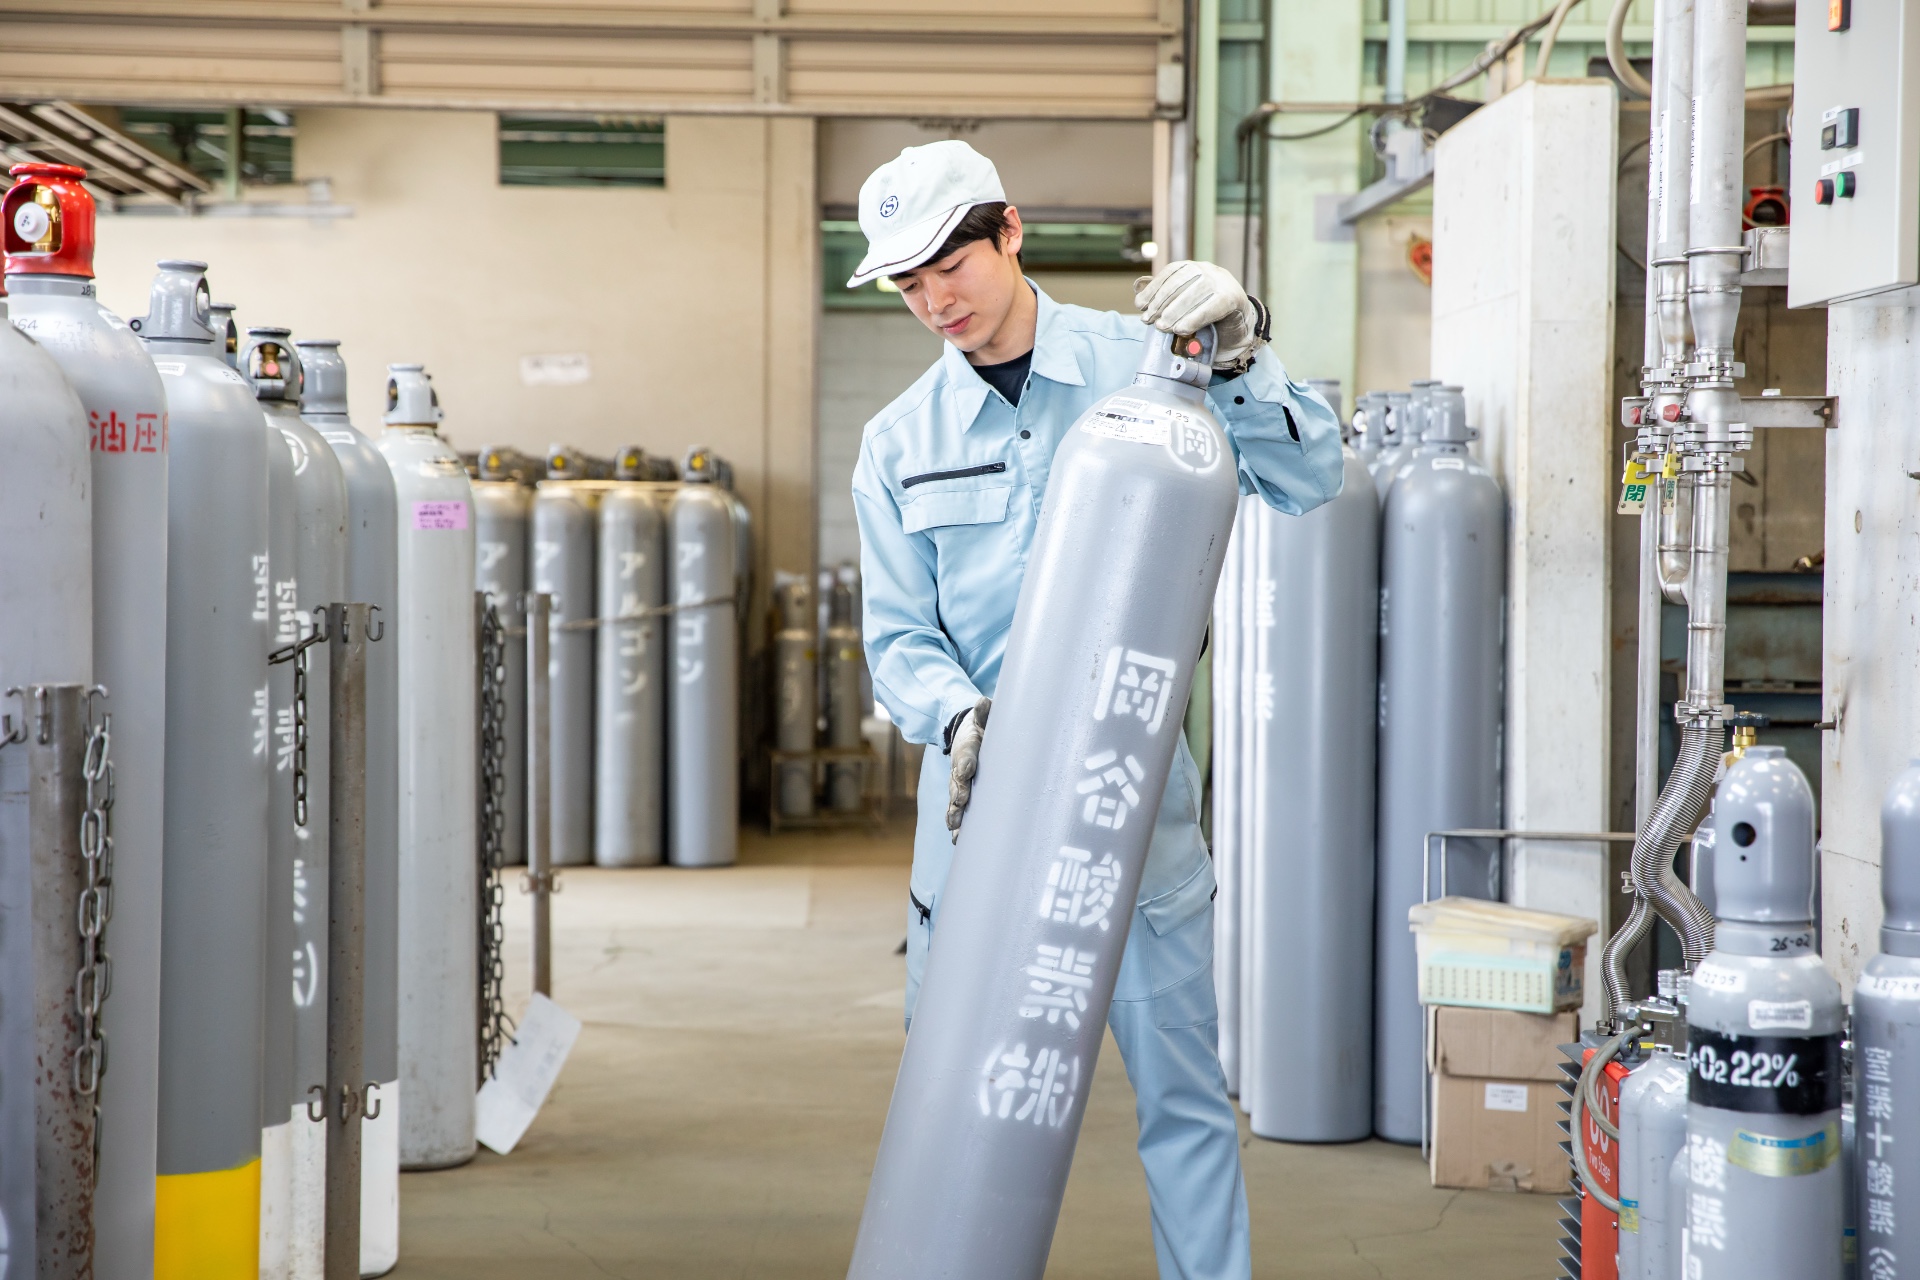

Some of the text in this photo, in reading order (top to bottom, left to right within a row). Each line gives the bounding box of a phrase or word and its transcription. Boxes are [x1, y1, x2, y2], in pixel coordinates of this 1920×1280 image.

[89, 411, 168, 452] 油圧
[1173, 416, 1216, 468] 岡
[1624, 484, 1646, 502] 閉
[1597, 1155, 1612, 1184] Stage
